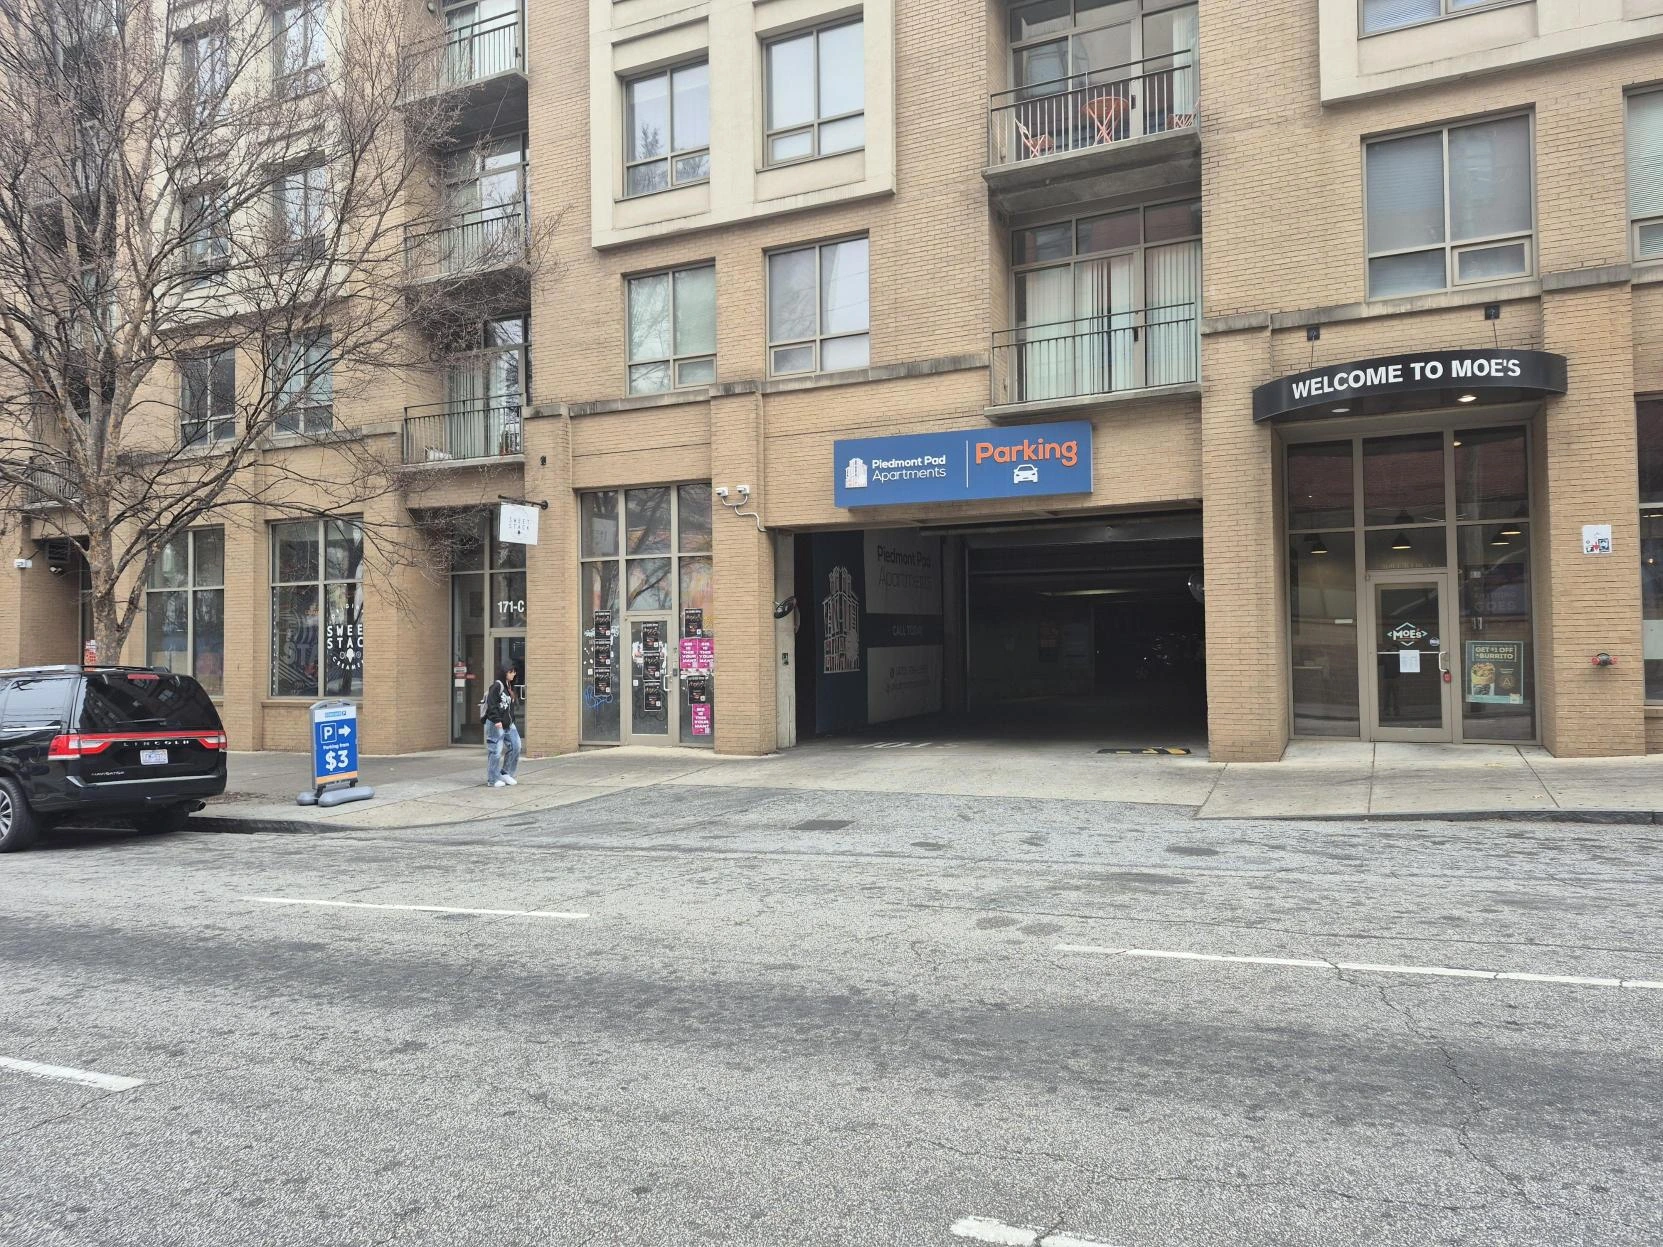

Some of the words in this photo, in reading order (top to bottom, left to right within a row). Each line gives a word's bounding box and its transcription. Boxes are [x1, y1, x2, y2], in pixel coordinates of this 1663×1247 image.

[1292, 364, 1403, 400] WELCOME
[1410, 361, 1444, 381] TO
[1451, 358, 1521, 378] MOE'S
[975, 438, 1078, 466] Parking
[872, 456, 922, 469] Piedmont
[924, 454, 946, 466] Pad
[872, 466, 947, 483] Apartments
[498, 600, 525, 613] 171-C
[323, 726, 333, 740] P
[325, 750, 349, 771] $3
